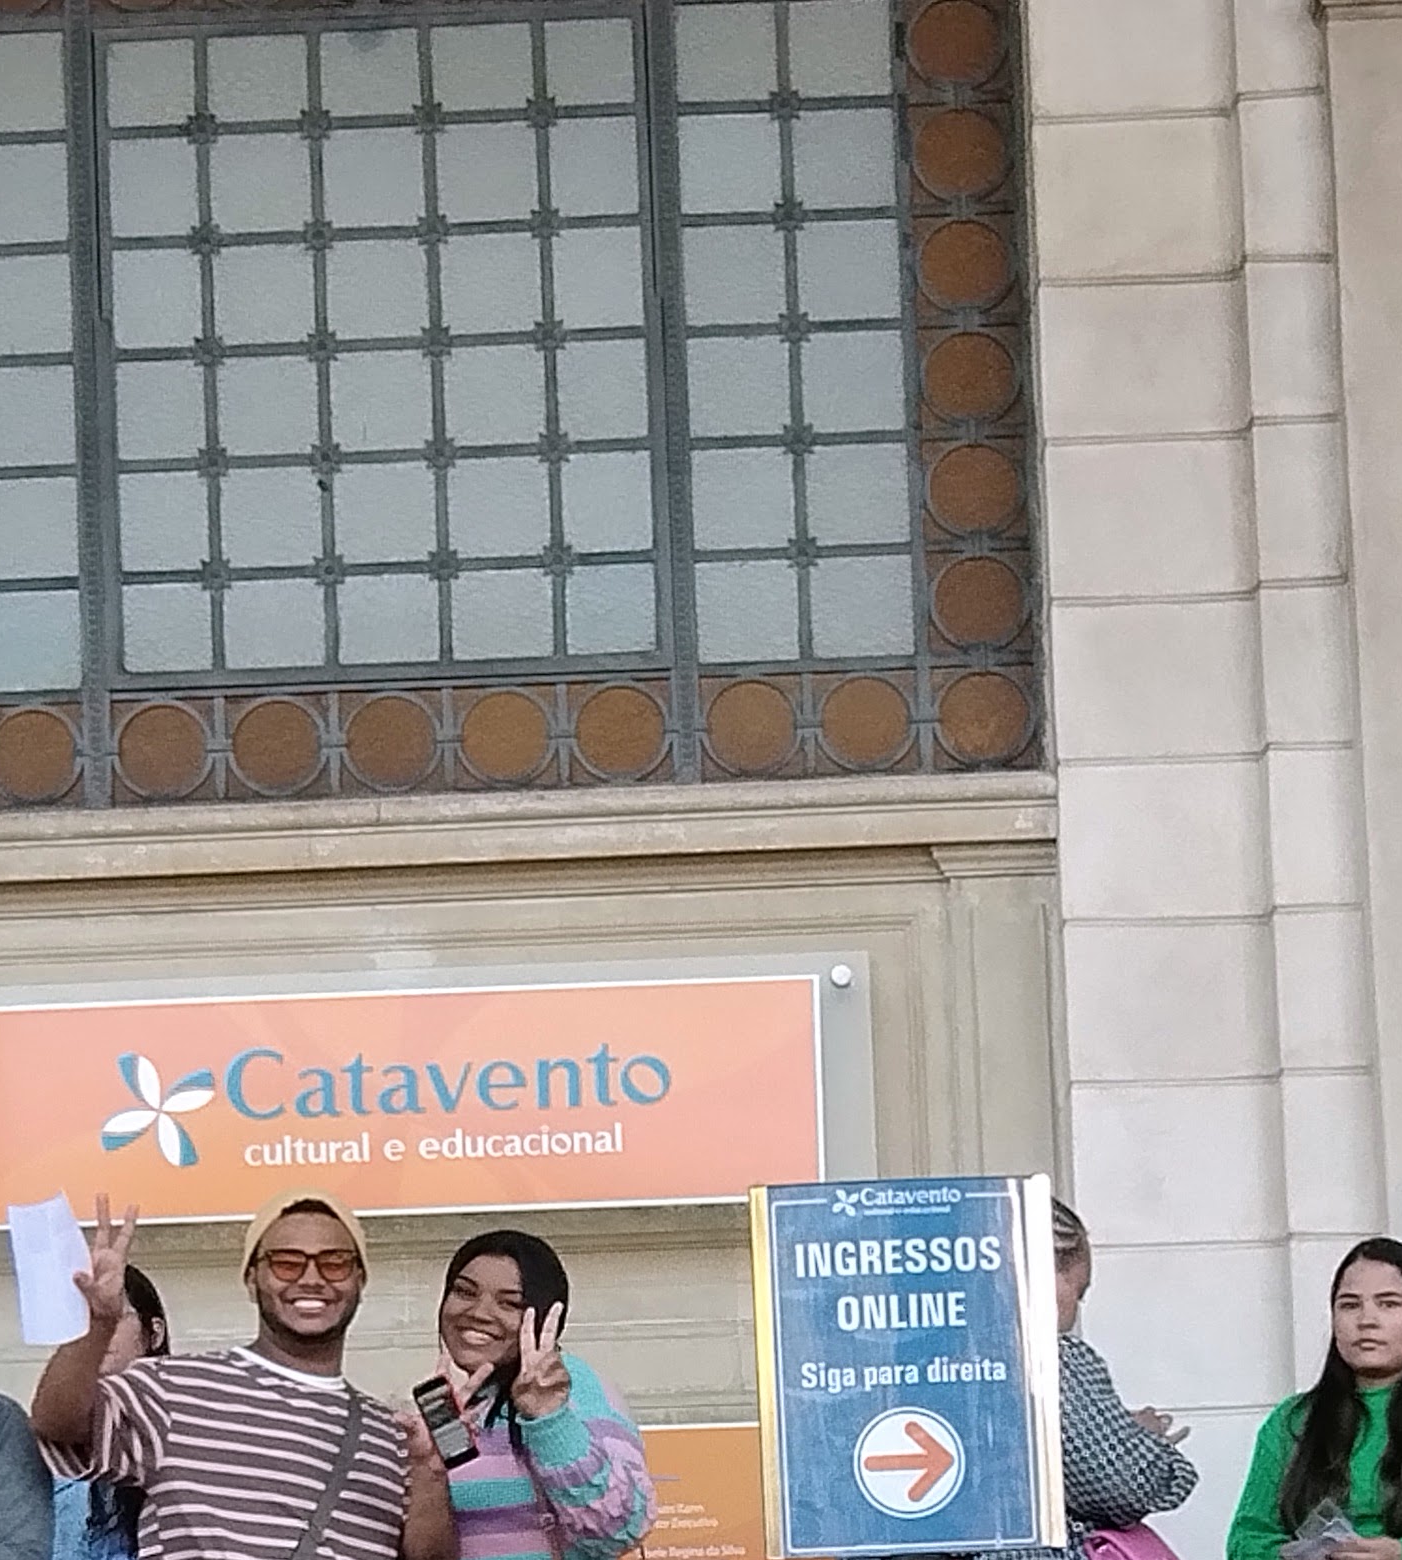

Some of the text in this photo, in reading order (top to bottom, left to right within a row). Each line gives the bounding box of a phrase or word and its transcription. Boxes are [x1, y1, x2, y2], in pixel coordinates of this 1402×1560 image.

[223, 1042, 672, 1121] Catavento
[244, 1122, 624, 1167] cultural e educacional
[860, 1186, 962, 1207] Catavento
[794, 1235, 1002, 1279] INGRESSOS
[836, 1291, 967, 1332] ONLINE
[801, 1355, 1007, 1394] Siga para direita
